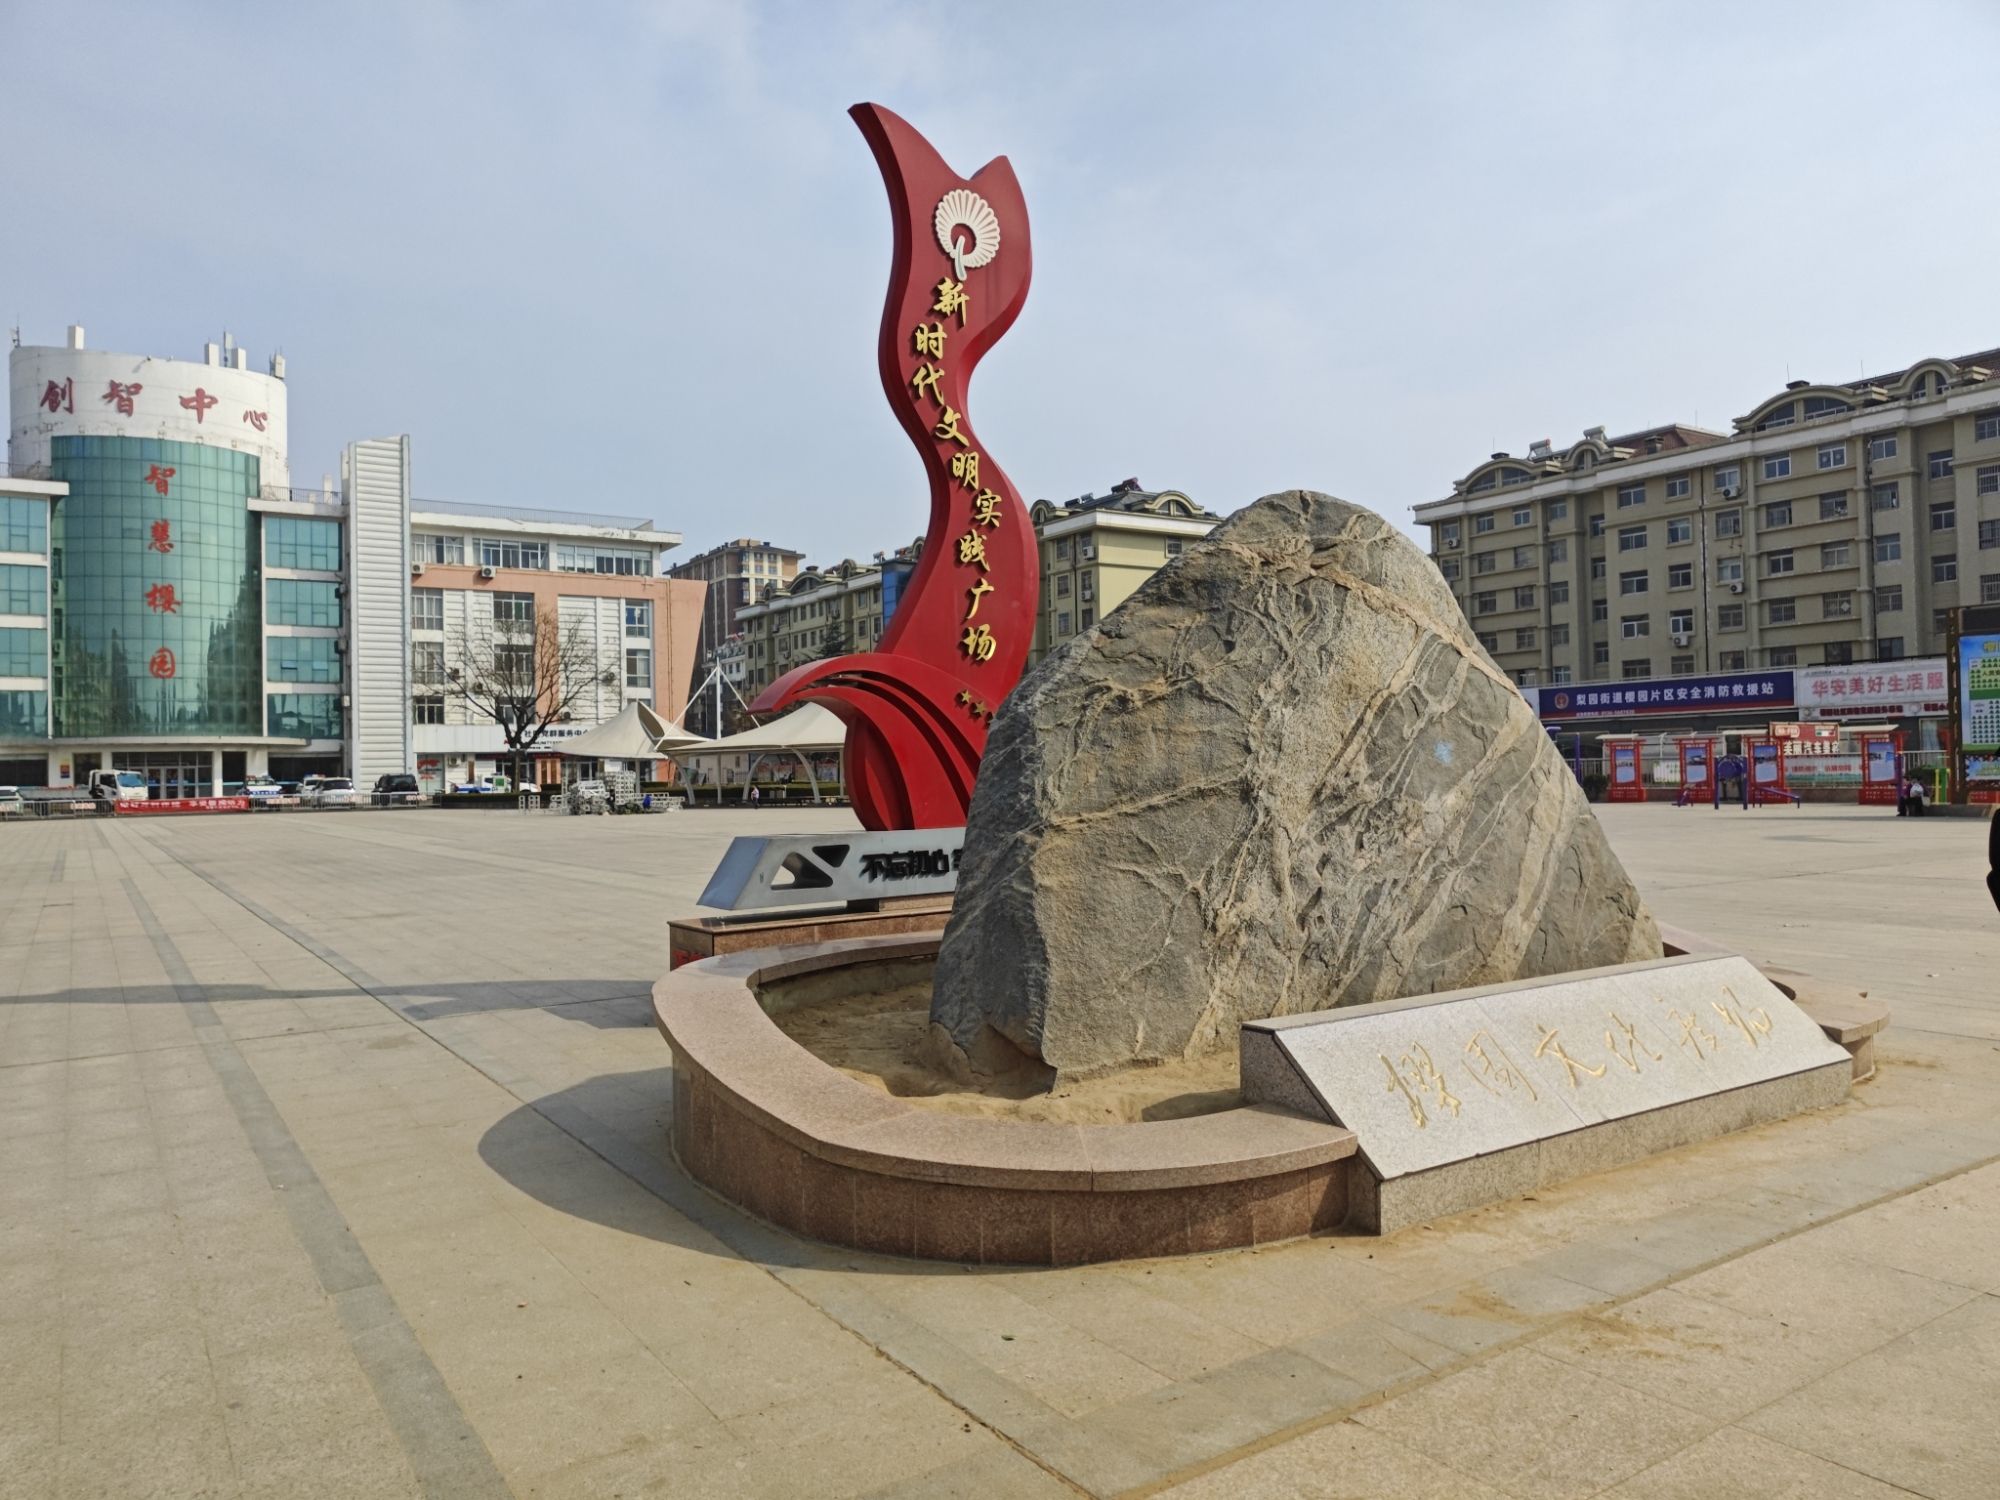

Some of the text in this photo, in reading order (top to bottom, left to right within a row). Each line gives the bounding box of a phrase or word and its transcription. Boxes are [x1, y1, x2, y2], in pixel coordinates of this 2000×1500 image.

[40, 376, 268, 433] 创智中心
[912, 277, 1003, 661] 新时代文明实践广场
